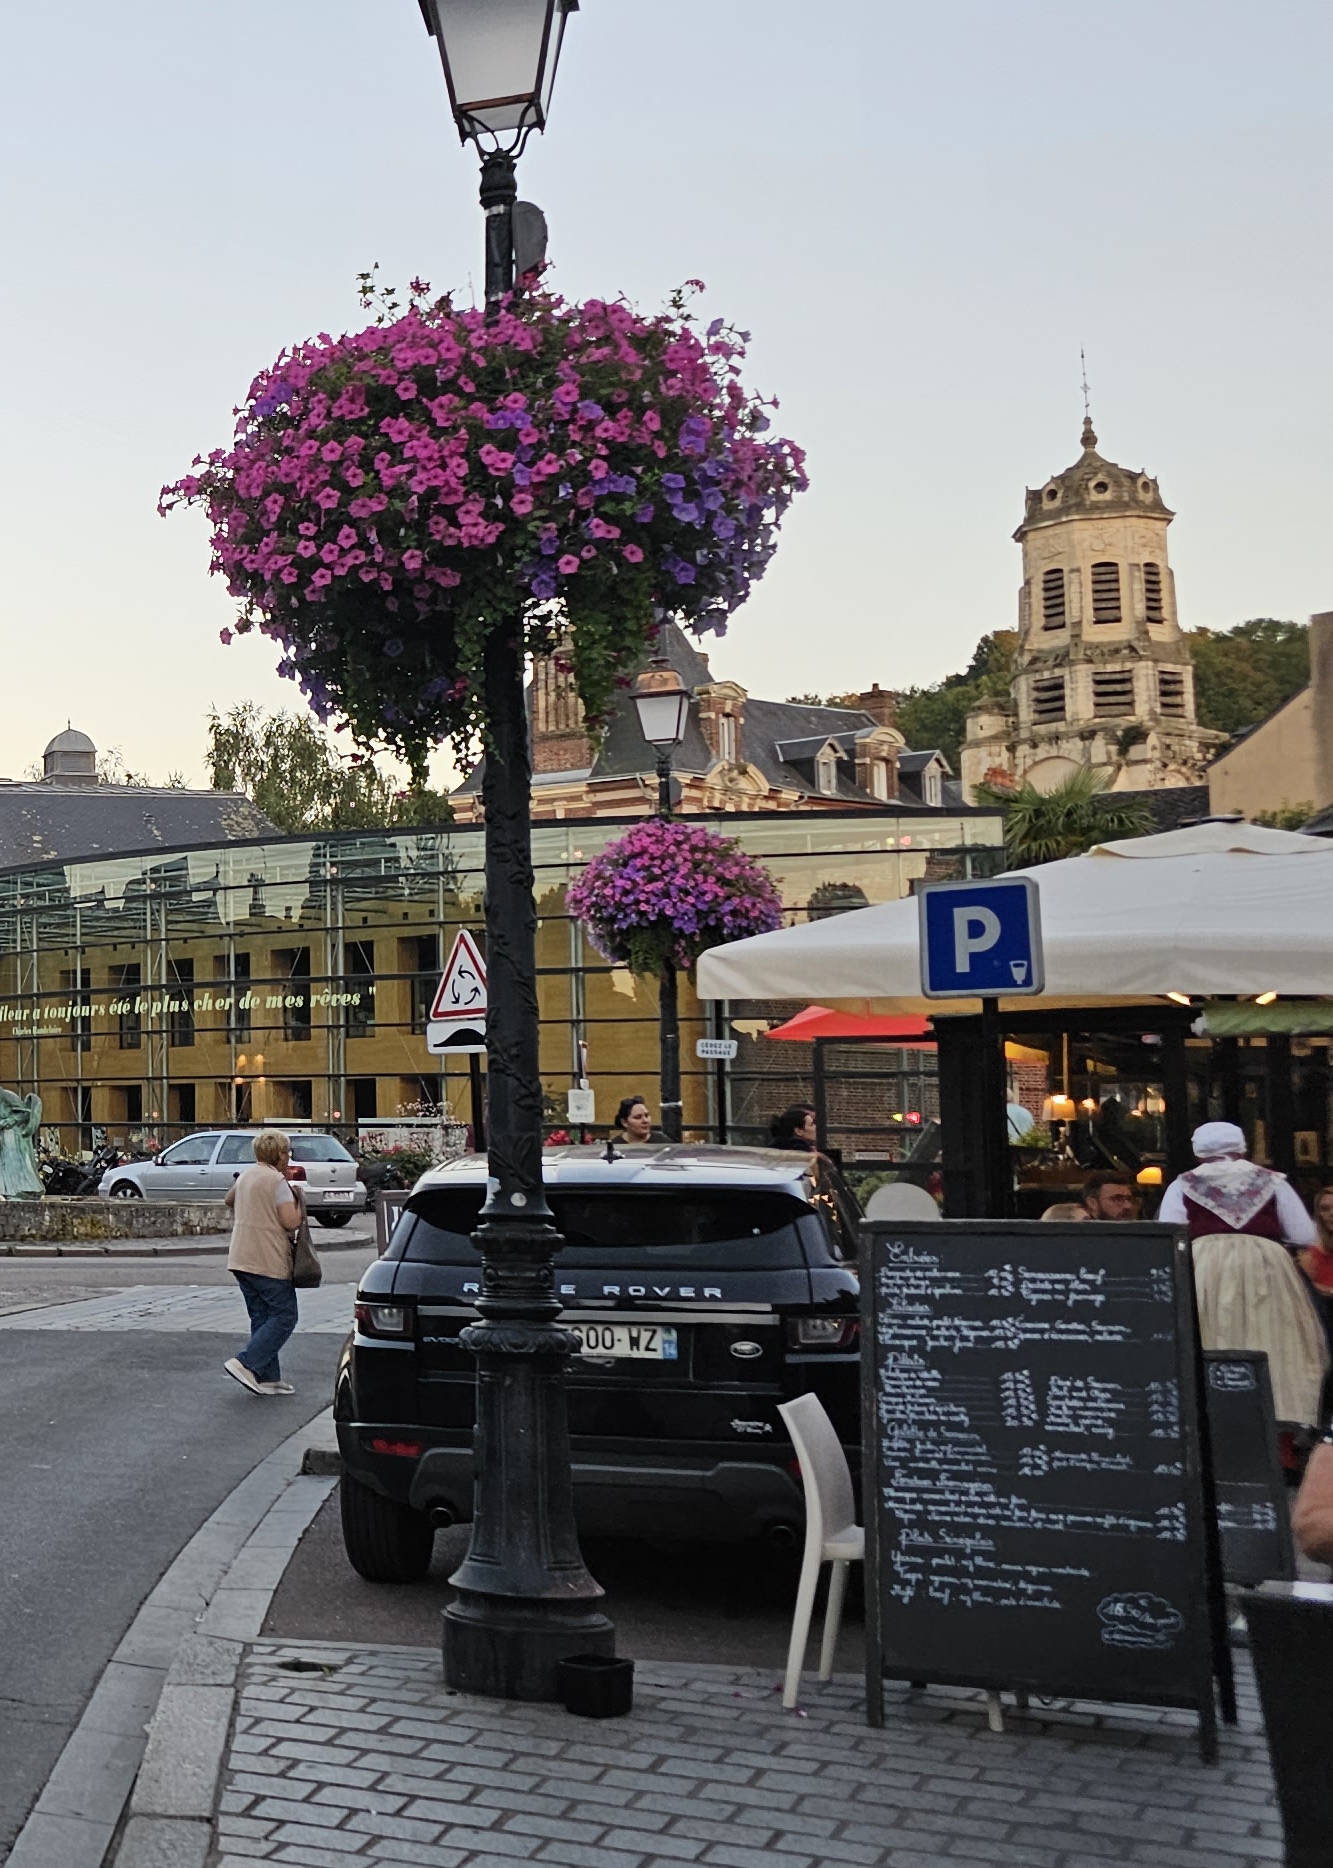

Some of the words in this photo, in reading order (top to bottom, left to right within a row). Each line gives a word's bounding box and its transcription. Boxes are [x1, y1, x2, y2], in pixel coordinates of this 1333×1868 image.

[953, 905, 1002, 973] P
[33, 1008, 41, 1020] a
[43, 1001, 105, 1022] toujours
[109, 998, 131, 1016] été
[134, 997, 148, 1014] le
[150, 993, 189, 1017] plus
[194, 992, 234, 1011] cher
[238, 990, 261, 1010] de
[265, 993, 304, 1009] mes
[309, 988, 361, 1008] rêves
[603, 1285, 723, 1299] ROVER
